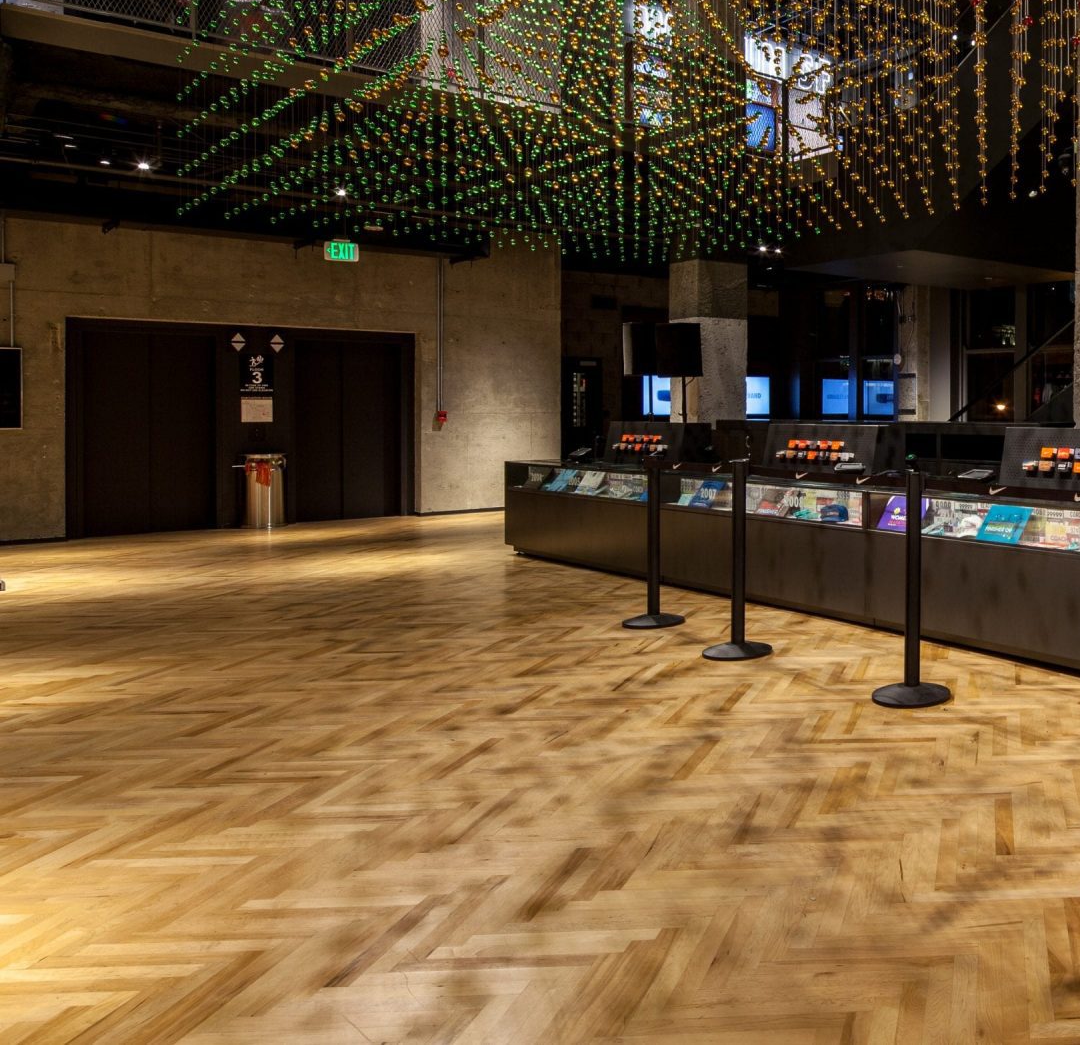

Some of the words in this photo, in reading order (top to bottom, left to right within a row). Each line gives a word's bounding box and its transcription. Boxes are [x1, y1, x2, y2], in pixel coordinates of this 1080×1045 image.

[330, 242, 356, 260] EXIT
[252, 371, 263, 384] 3
[700, 487, 717, 500] 2007
